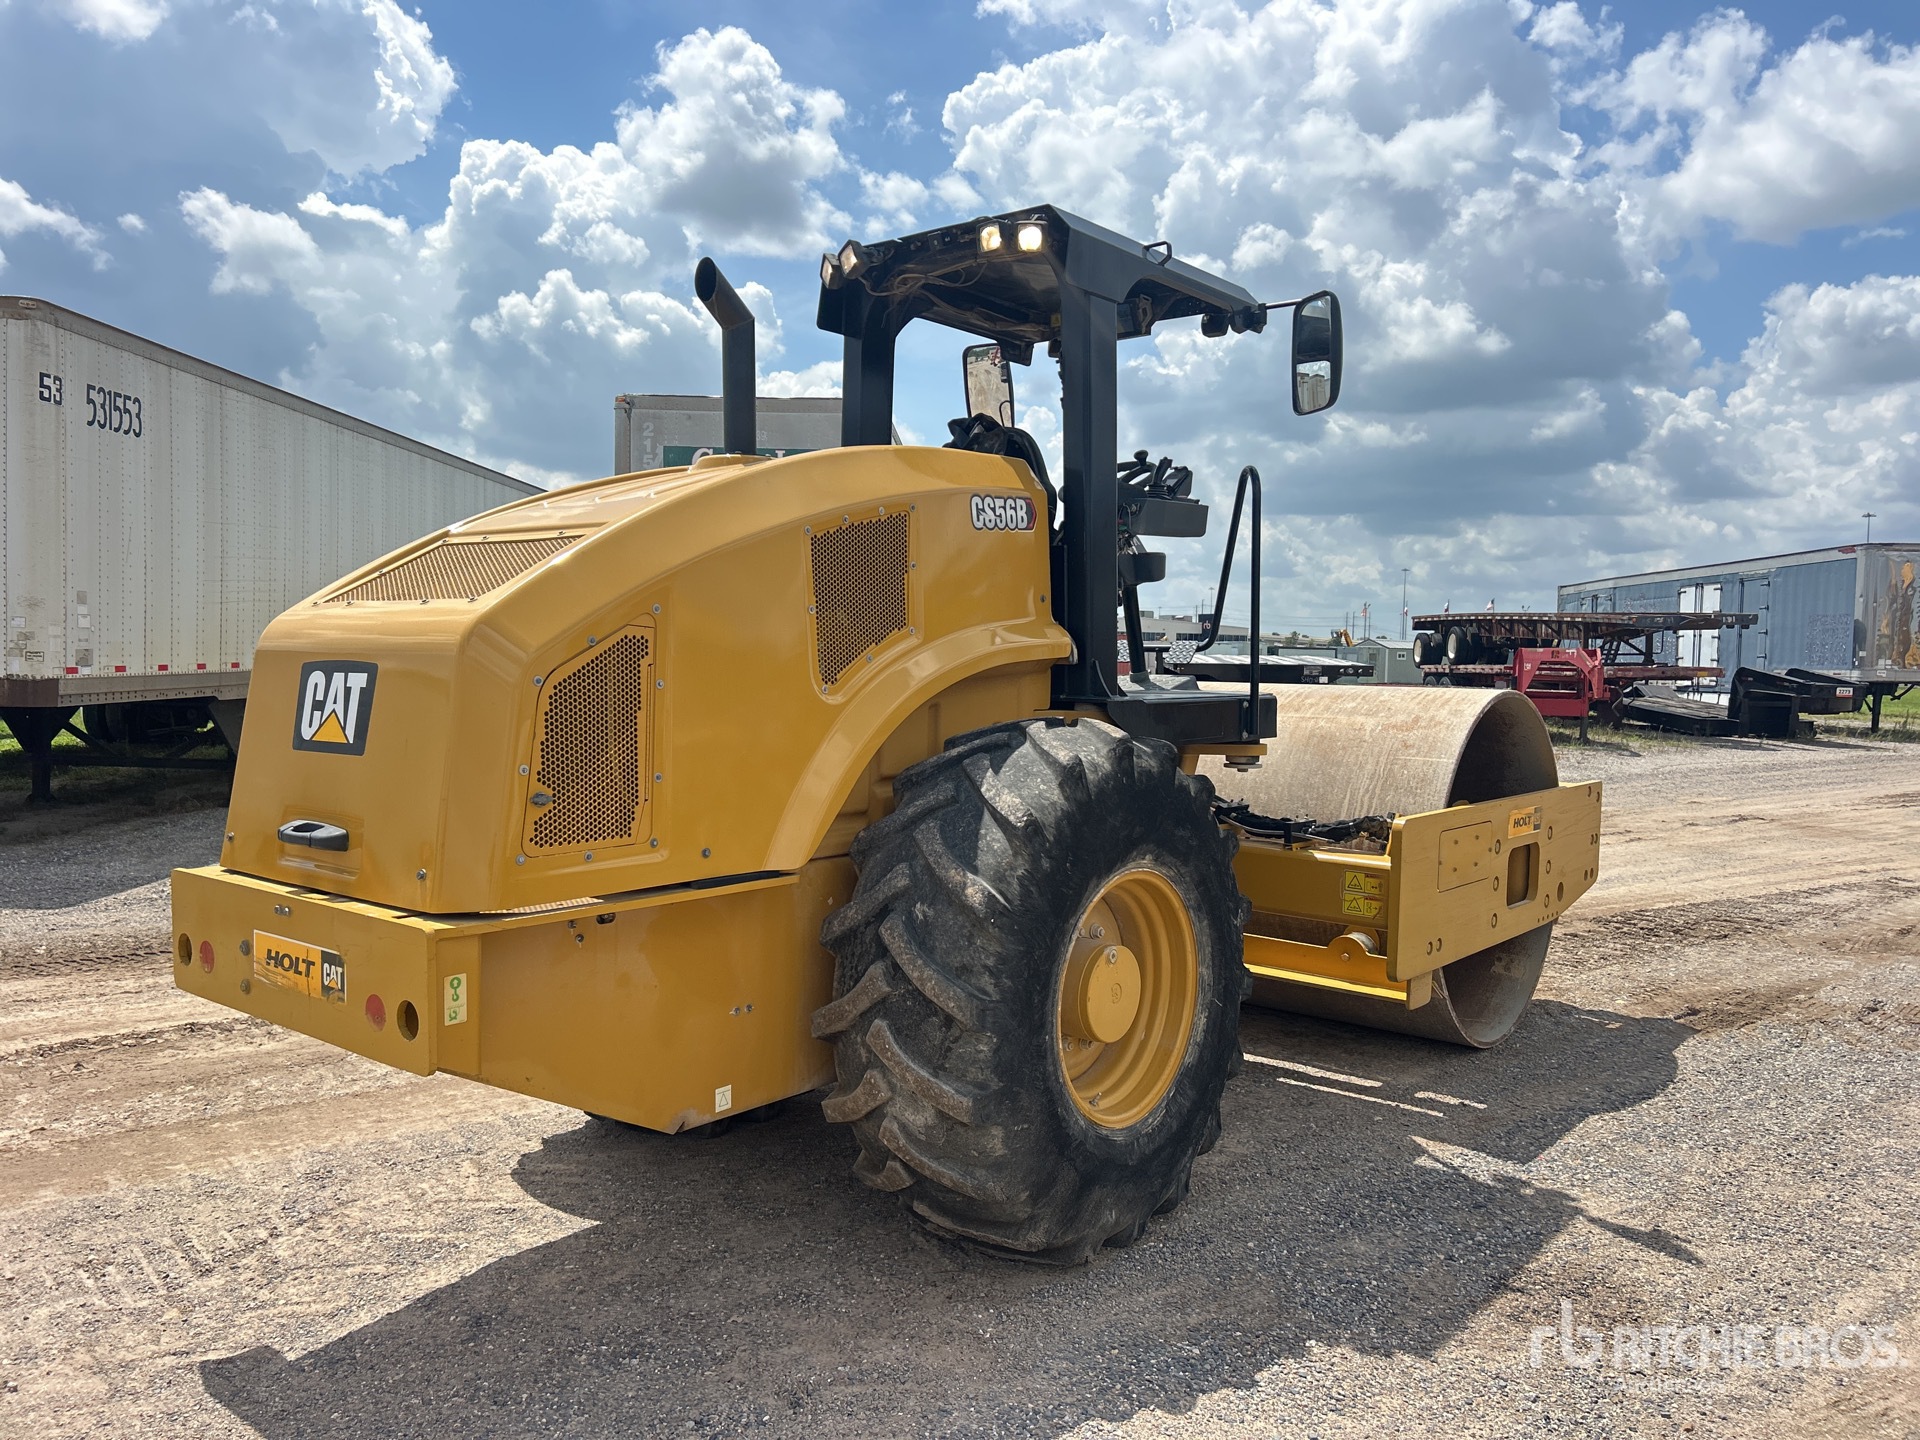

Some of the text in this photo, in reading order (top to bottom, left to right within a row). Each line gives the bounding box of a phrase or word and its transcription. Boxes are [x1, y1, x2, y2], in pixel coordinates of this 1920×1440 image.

[39, 372, 63, 405] 53
[86, 383, 142, 438] 531553
[971, 495, 1028, 529] CS56B
[300, 669, 369, 745] CAT
[1513, 816, 1531, 828] HOLT
[265, 948, 343, 990] HOLT CAT
